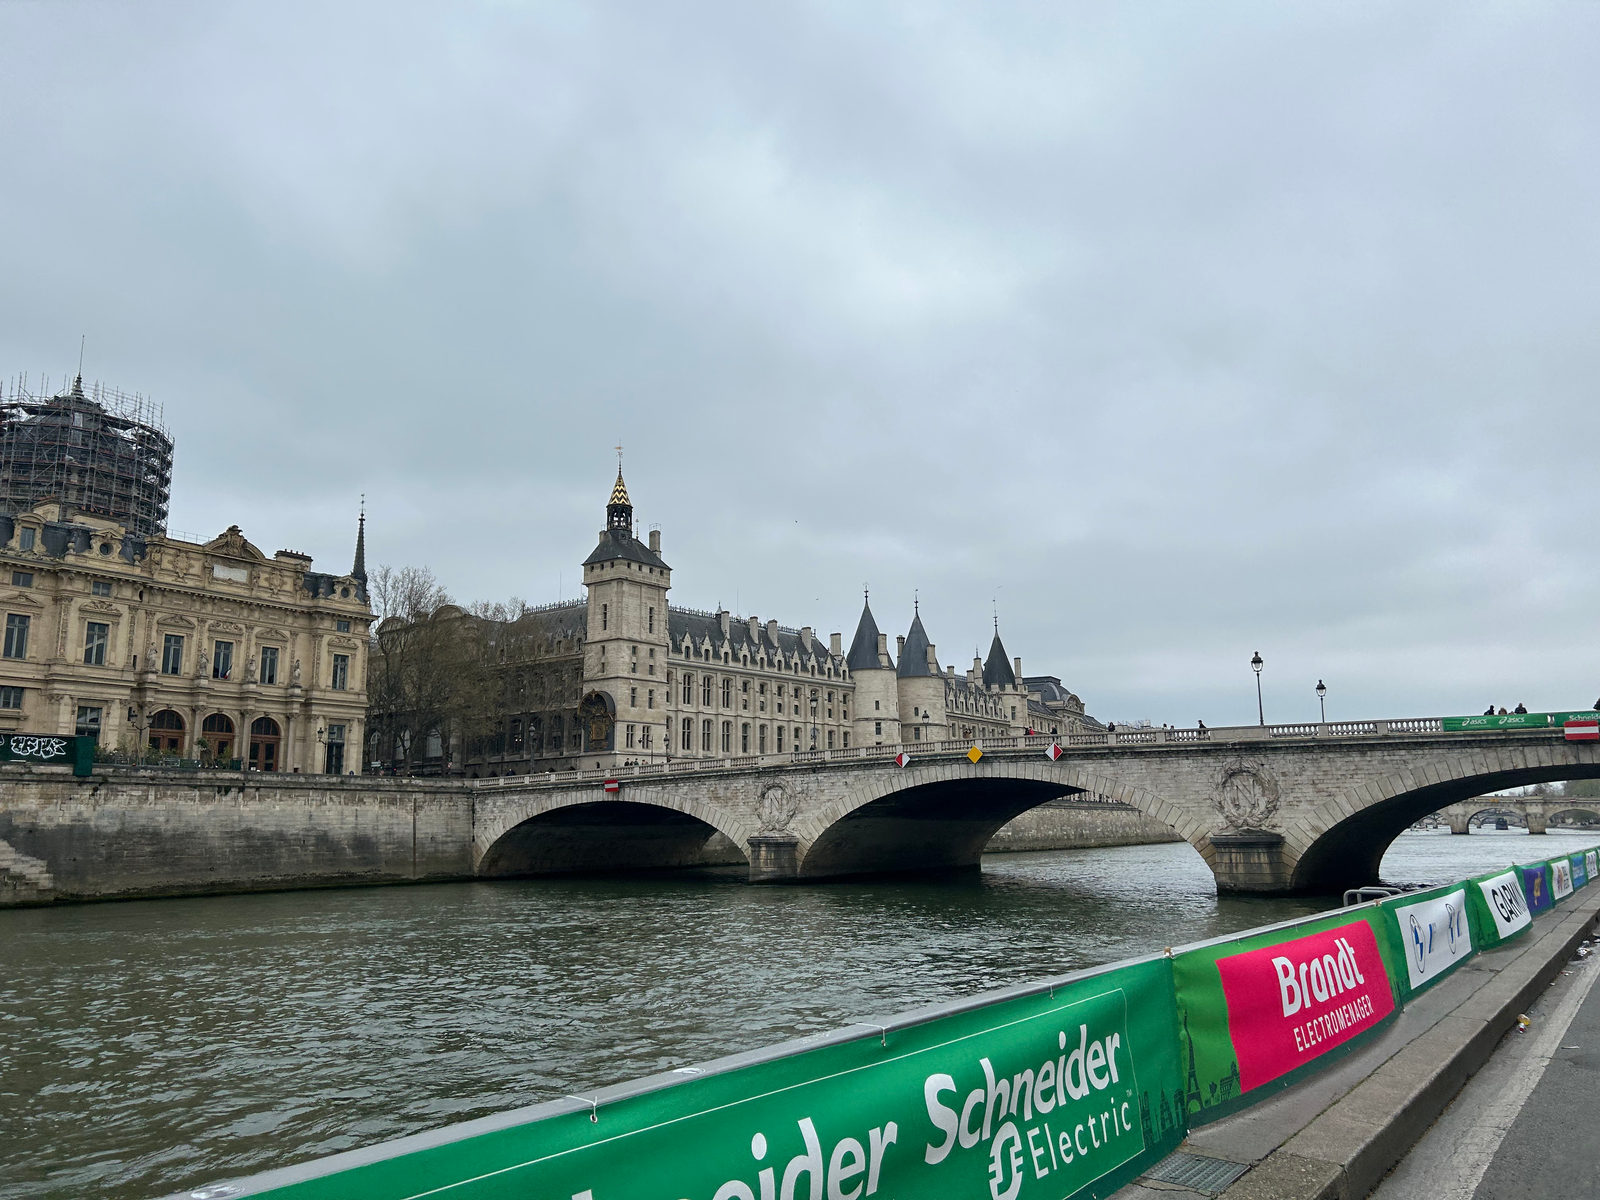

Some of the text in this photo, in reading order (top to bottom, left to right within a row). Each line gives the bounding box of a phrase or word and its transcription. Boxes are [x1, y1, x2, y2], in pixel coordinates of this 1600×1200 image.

[1231, 778, 1256, 806] N
[1272, 938, 1365, 1018] Brandt
[1293, 994, 1374, 1052] ELECTROMENAGER
[924, 1024, 1120, 1165] Schneider
[1026, 1096, 1132, 1180] Electric
